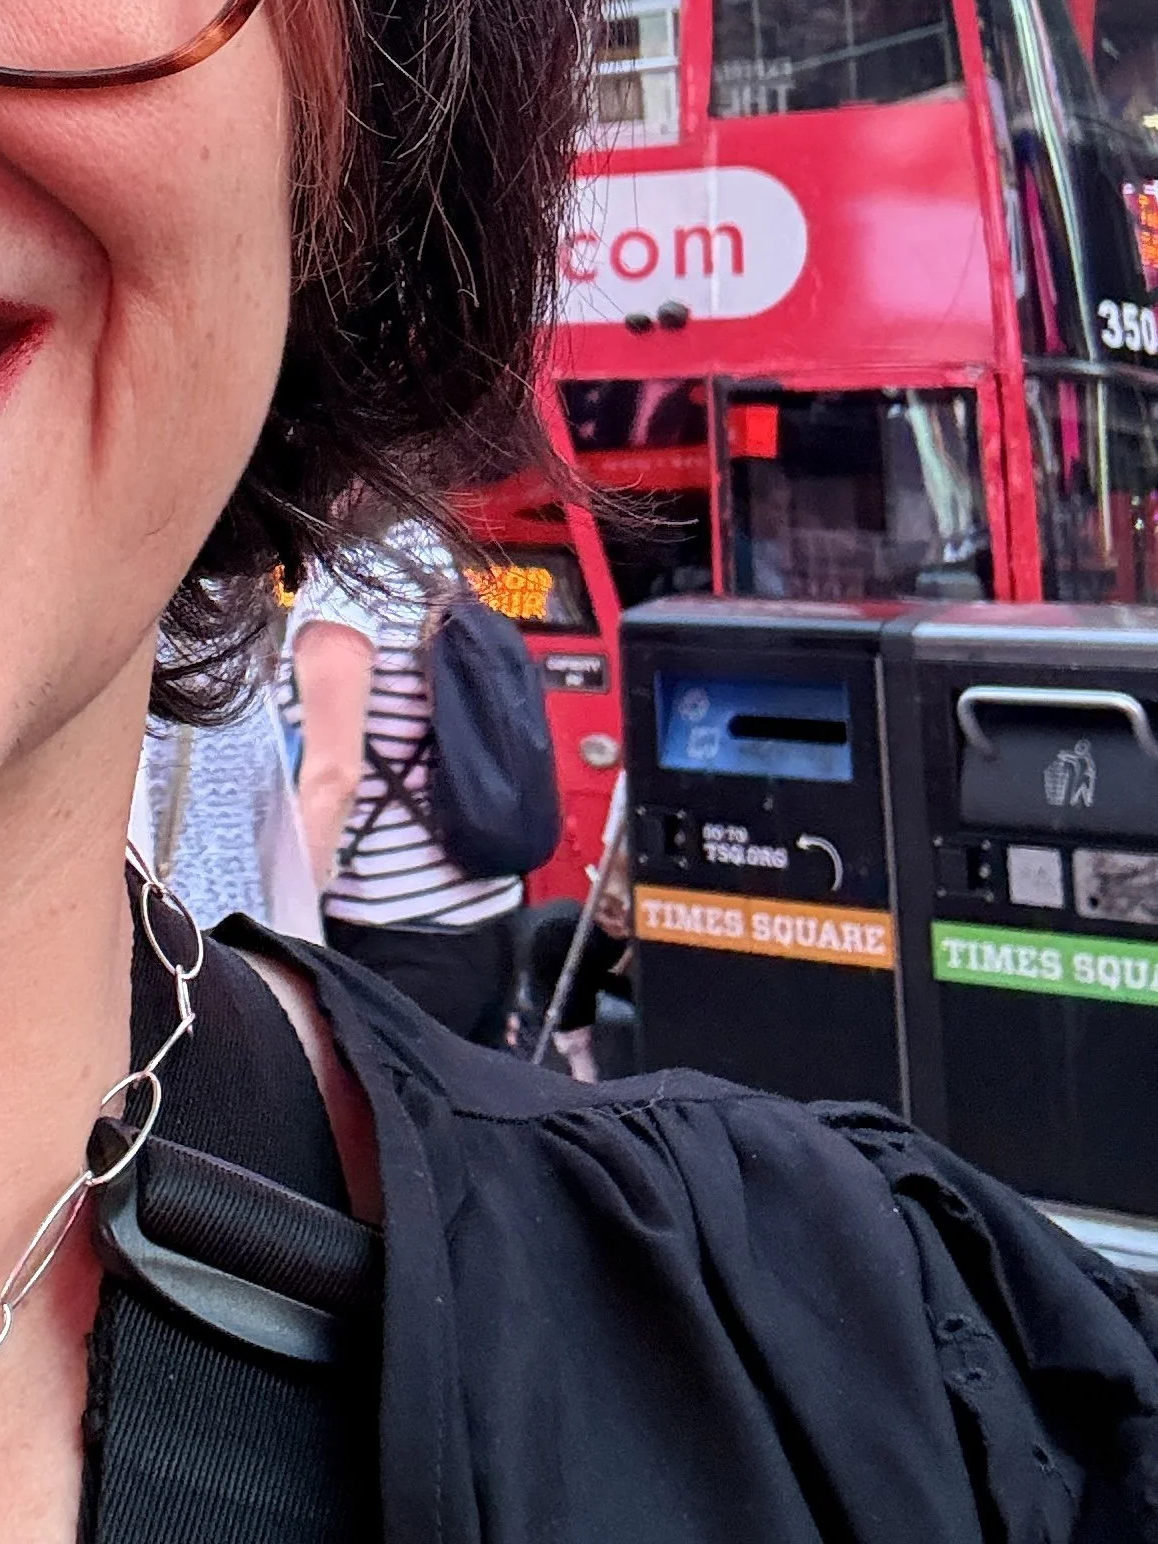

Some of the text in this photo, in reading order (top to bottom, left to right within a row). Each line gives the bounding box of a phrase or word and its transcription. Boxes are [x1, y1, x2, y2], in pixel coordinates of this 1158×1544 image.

[559, 221, 747, 283] com
[642, 898, 887, 956] TIMES SQUARE
[941, 936, 1064, 981] TIMES
